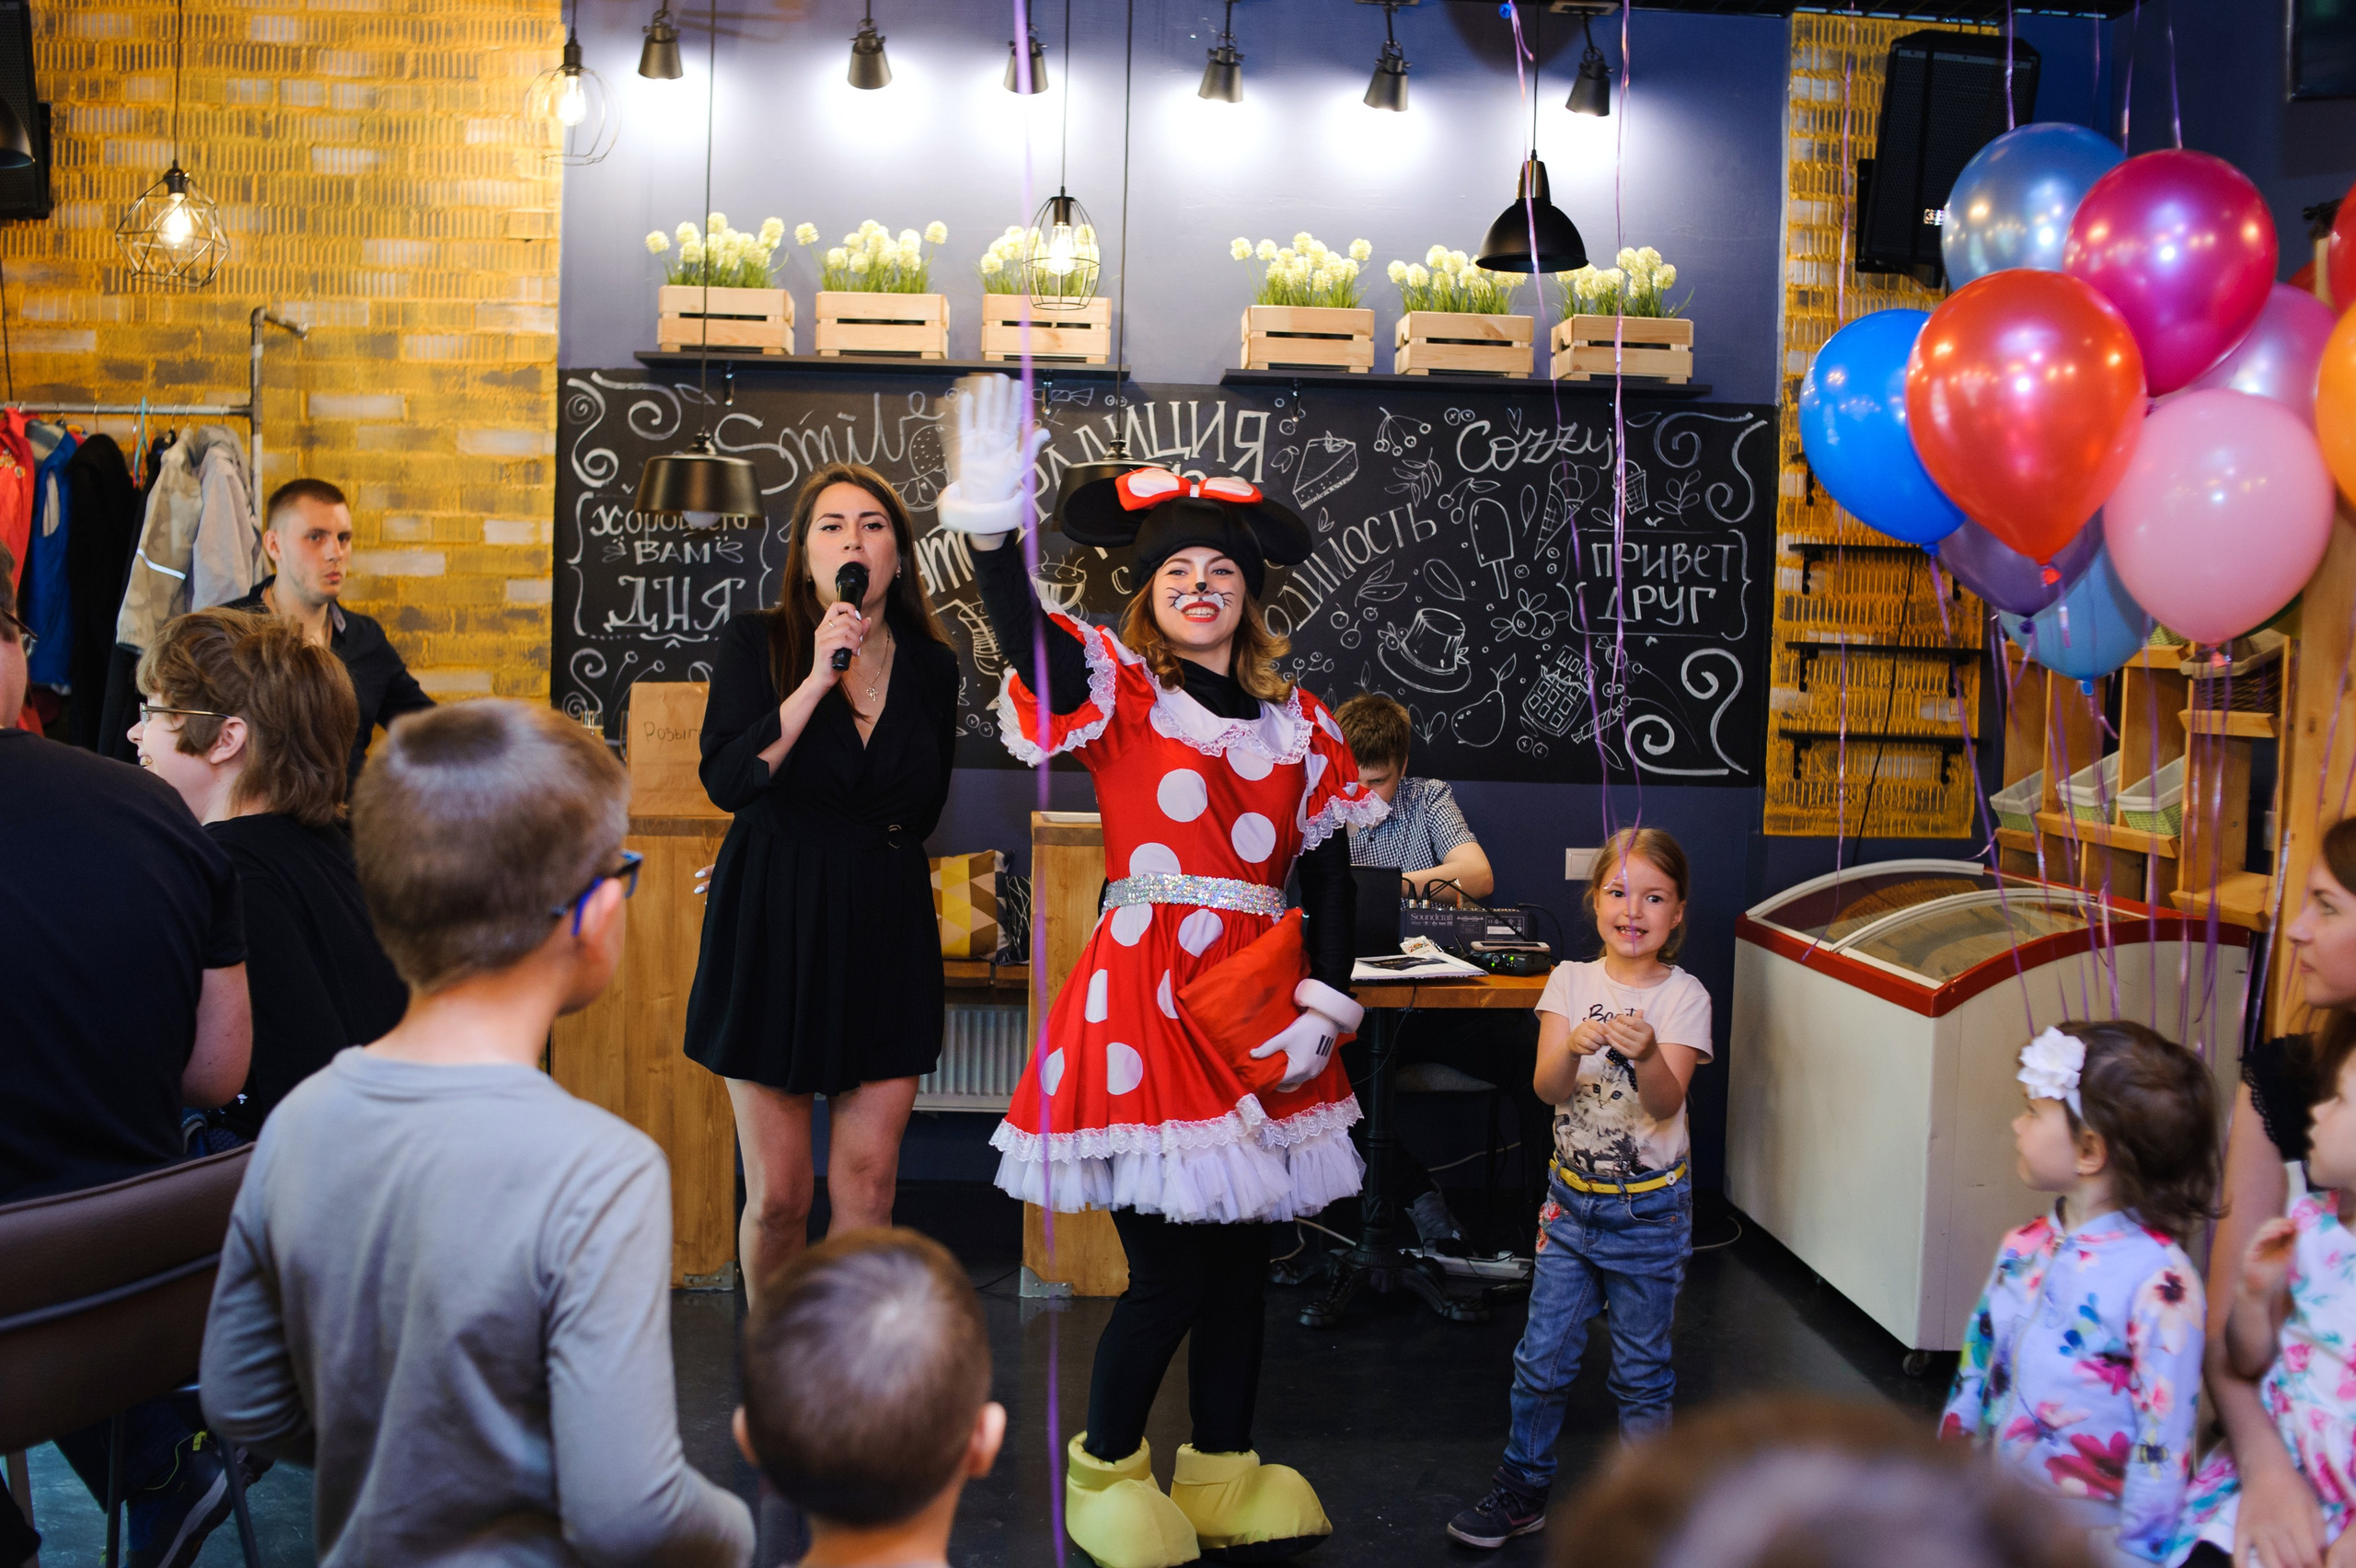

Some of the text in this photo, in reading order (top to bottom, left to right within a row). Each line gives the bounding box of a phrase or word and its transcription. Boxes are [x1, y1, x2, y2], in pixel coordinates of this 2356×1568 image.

[714, 390, 946, 495] Smile
[633, 539, 710, 565] ВАМ
[603, 574, 746, 633] ДНЯ
[1597, 584, 1716, 626] ДРУГ
[643, 721, 702, 744] Розыг
[1410, 912, 1453, 921] Soundcraft
